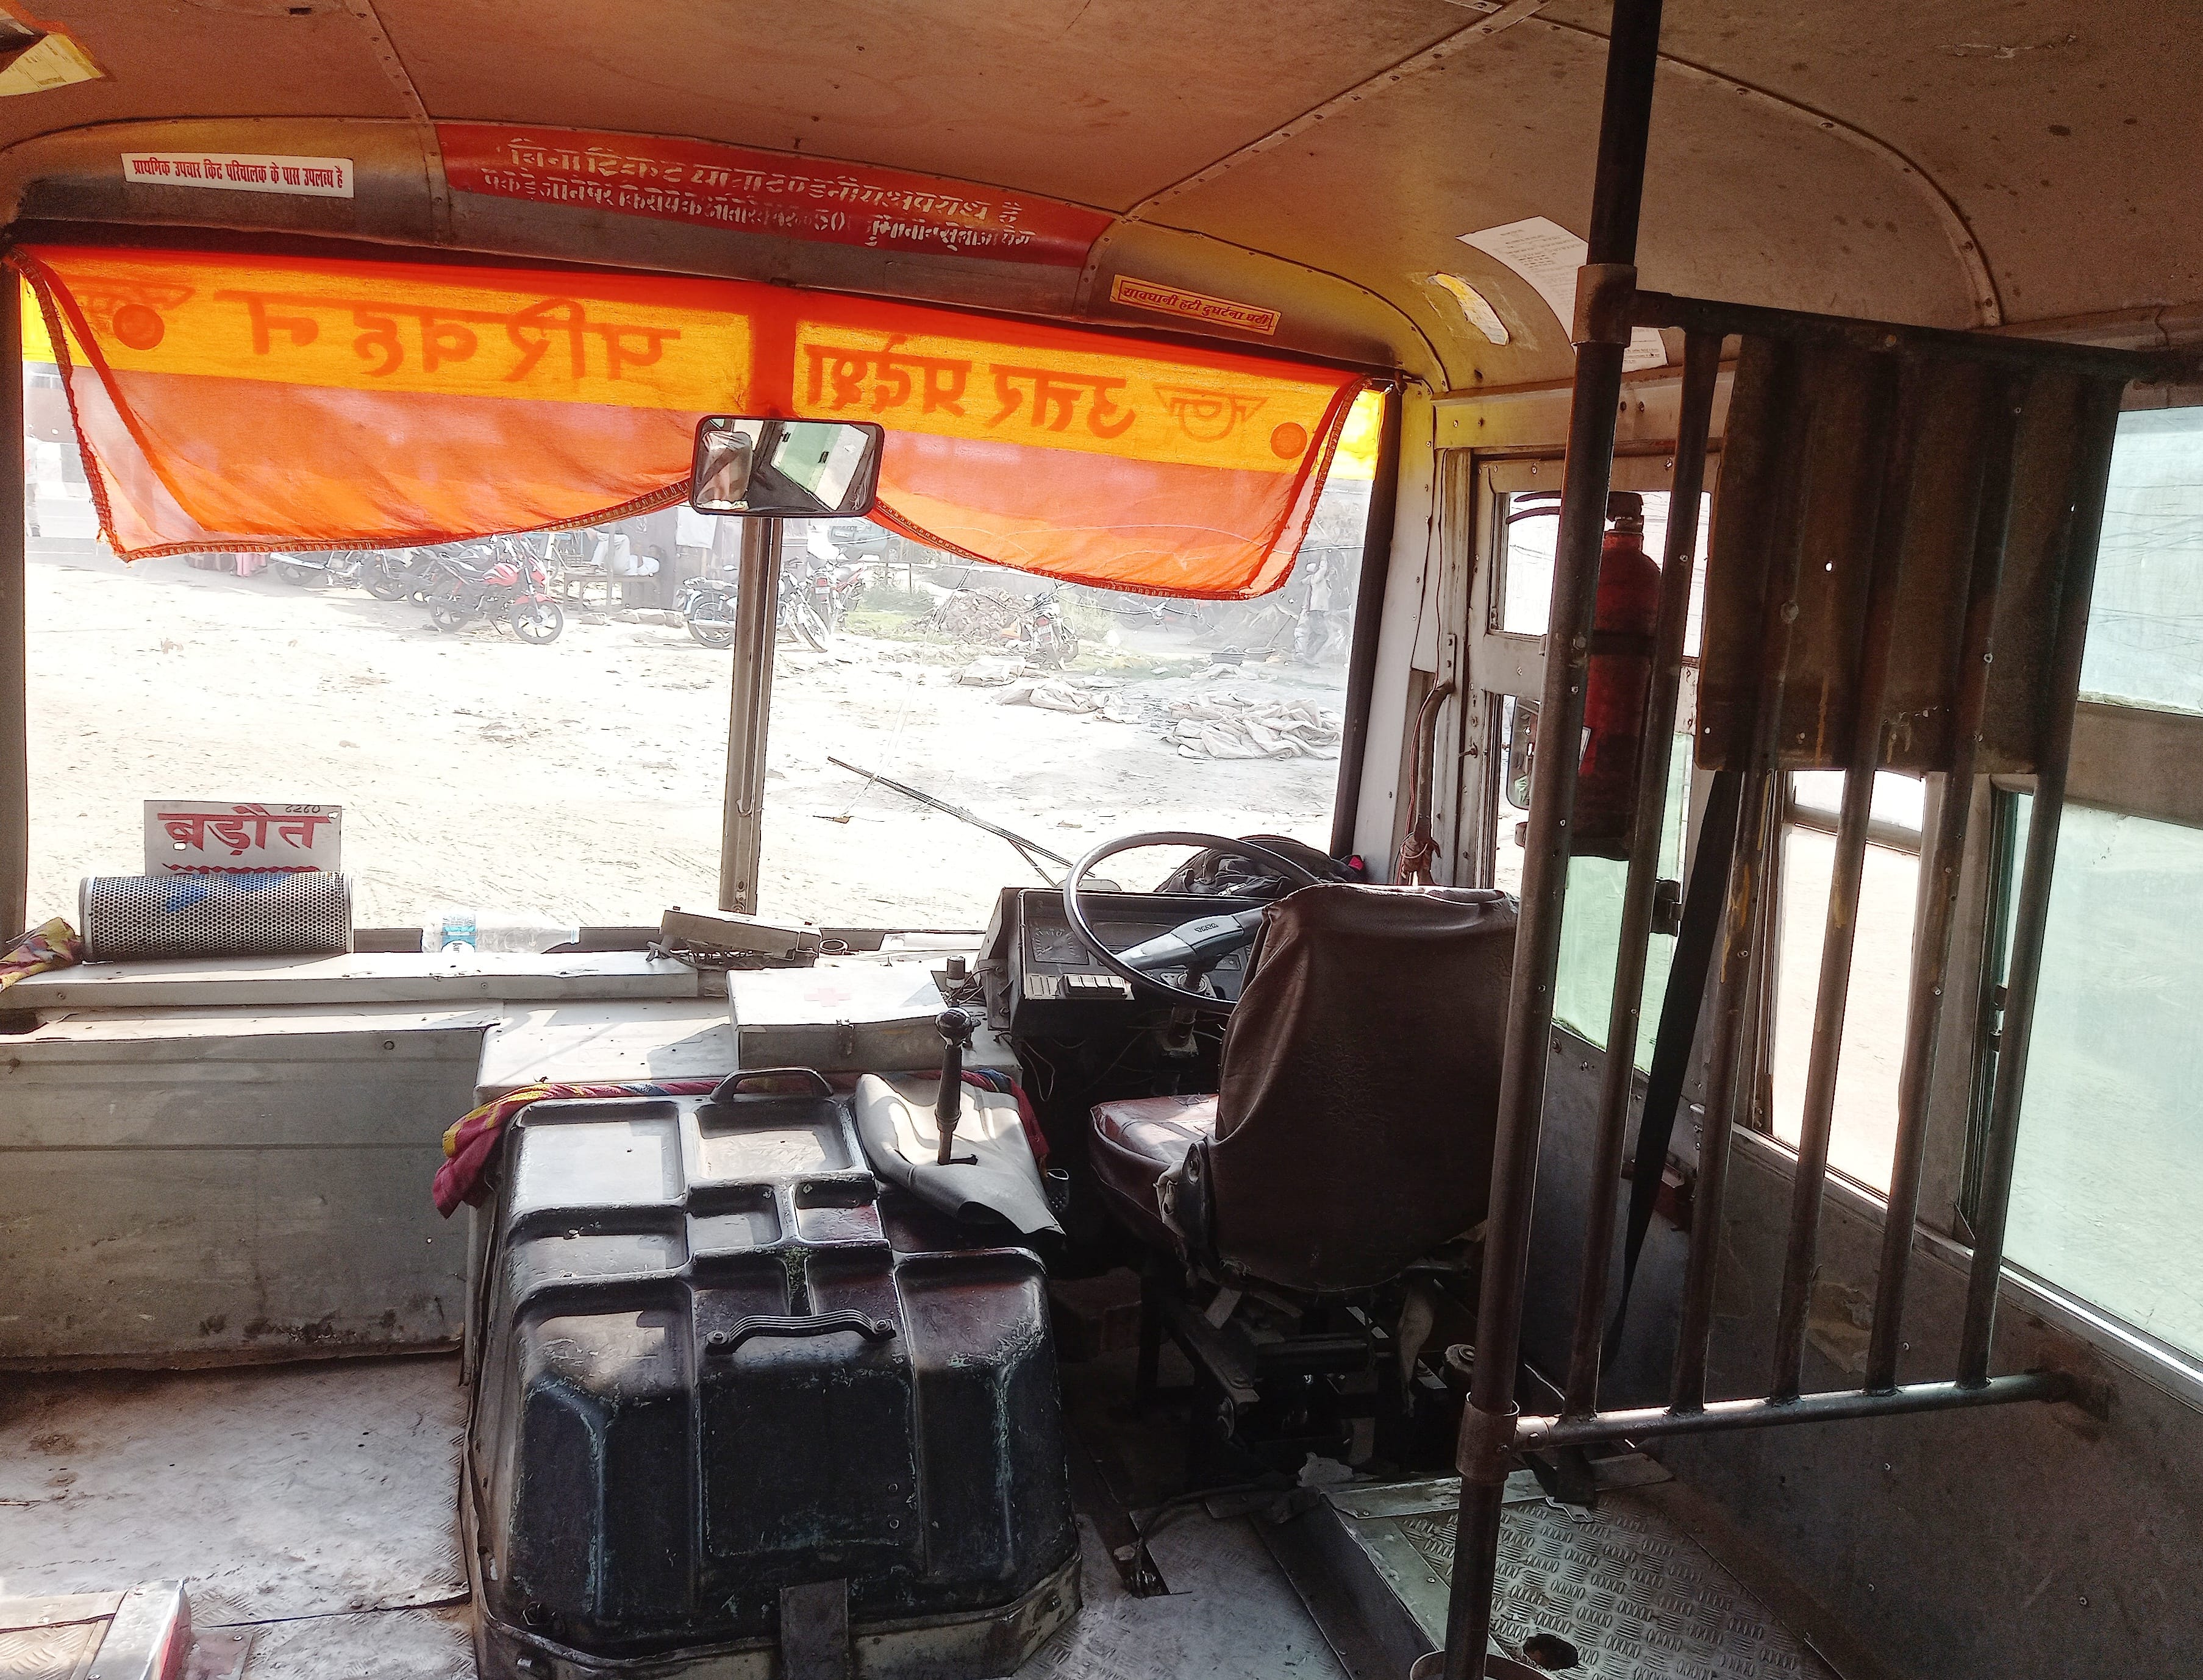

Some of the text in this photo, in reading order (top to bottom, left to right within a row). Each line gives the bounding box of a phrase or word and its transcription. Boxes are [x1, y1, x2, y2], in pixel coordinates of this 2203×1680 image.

[173, 161, 201, 178] उपचार
[203, 158, 223, 179] किट
[225, 160, 266, 183] परिचालक
[270, 162, 279, 183] के
[282, 166, 300, 185] पास
[335, 166, 343, 188] है
[1123, 288, 1178, 307] सावधानी
[1179, 299, 1202, 311] हटी
[1246, 313, 1269, 325] घटी
[157, 803, 332, 856] बड़ौत
[1194, 923, 1219, 933] TATA
